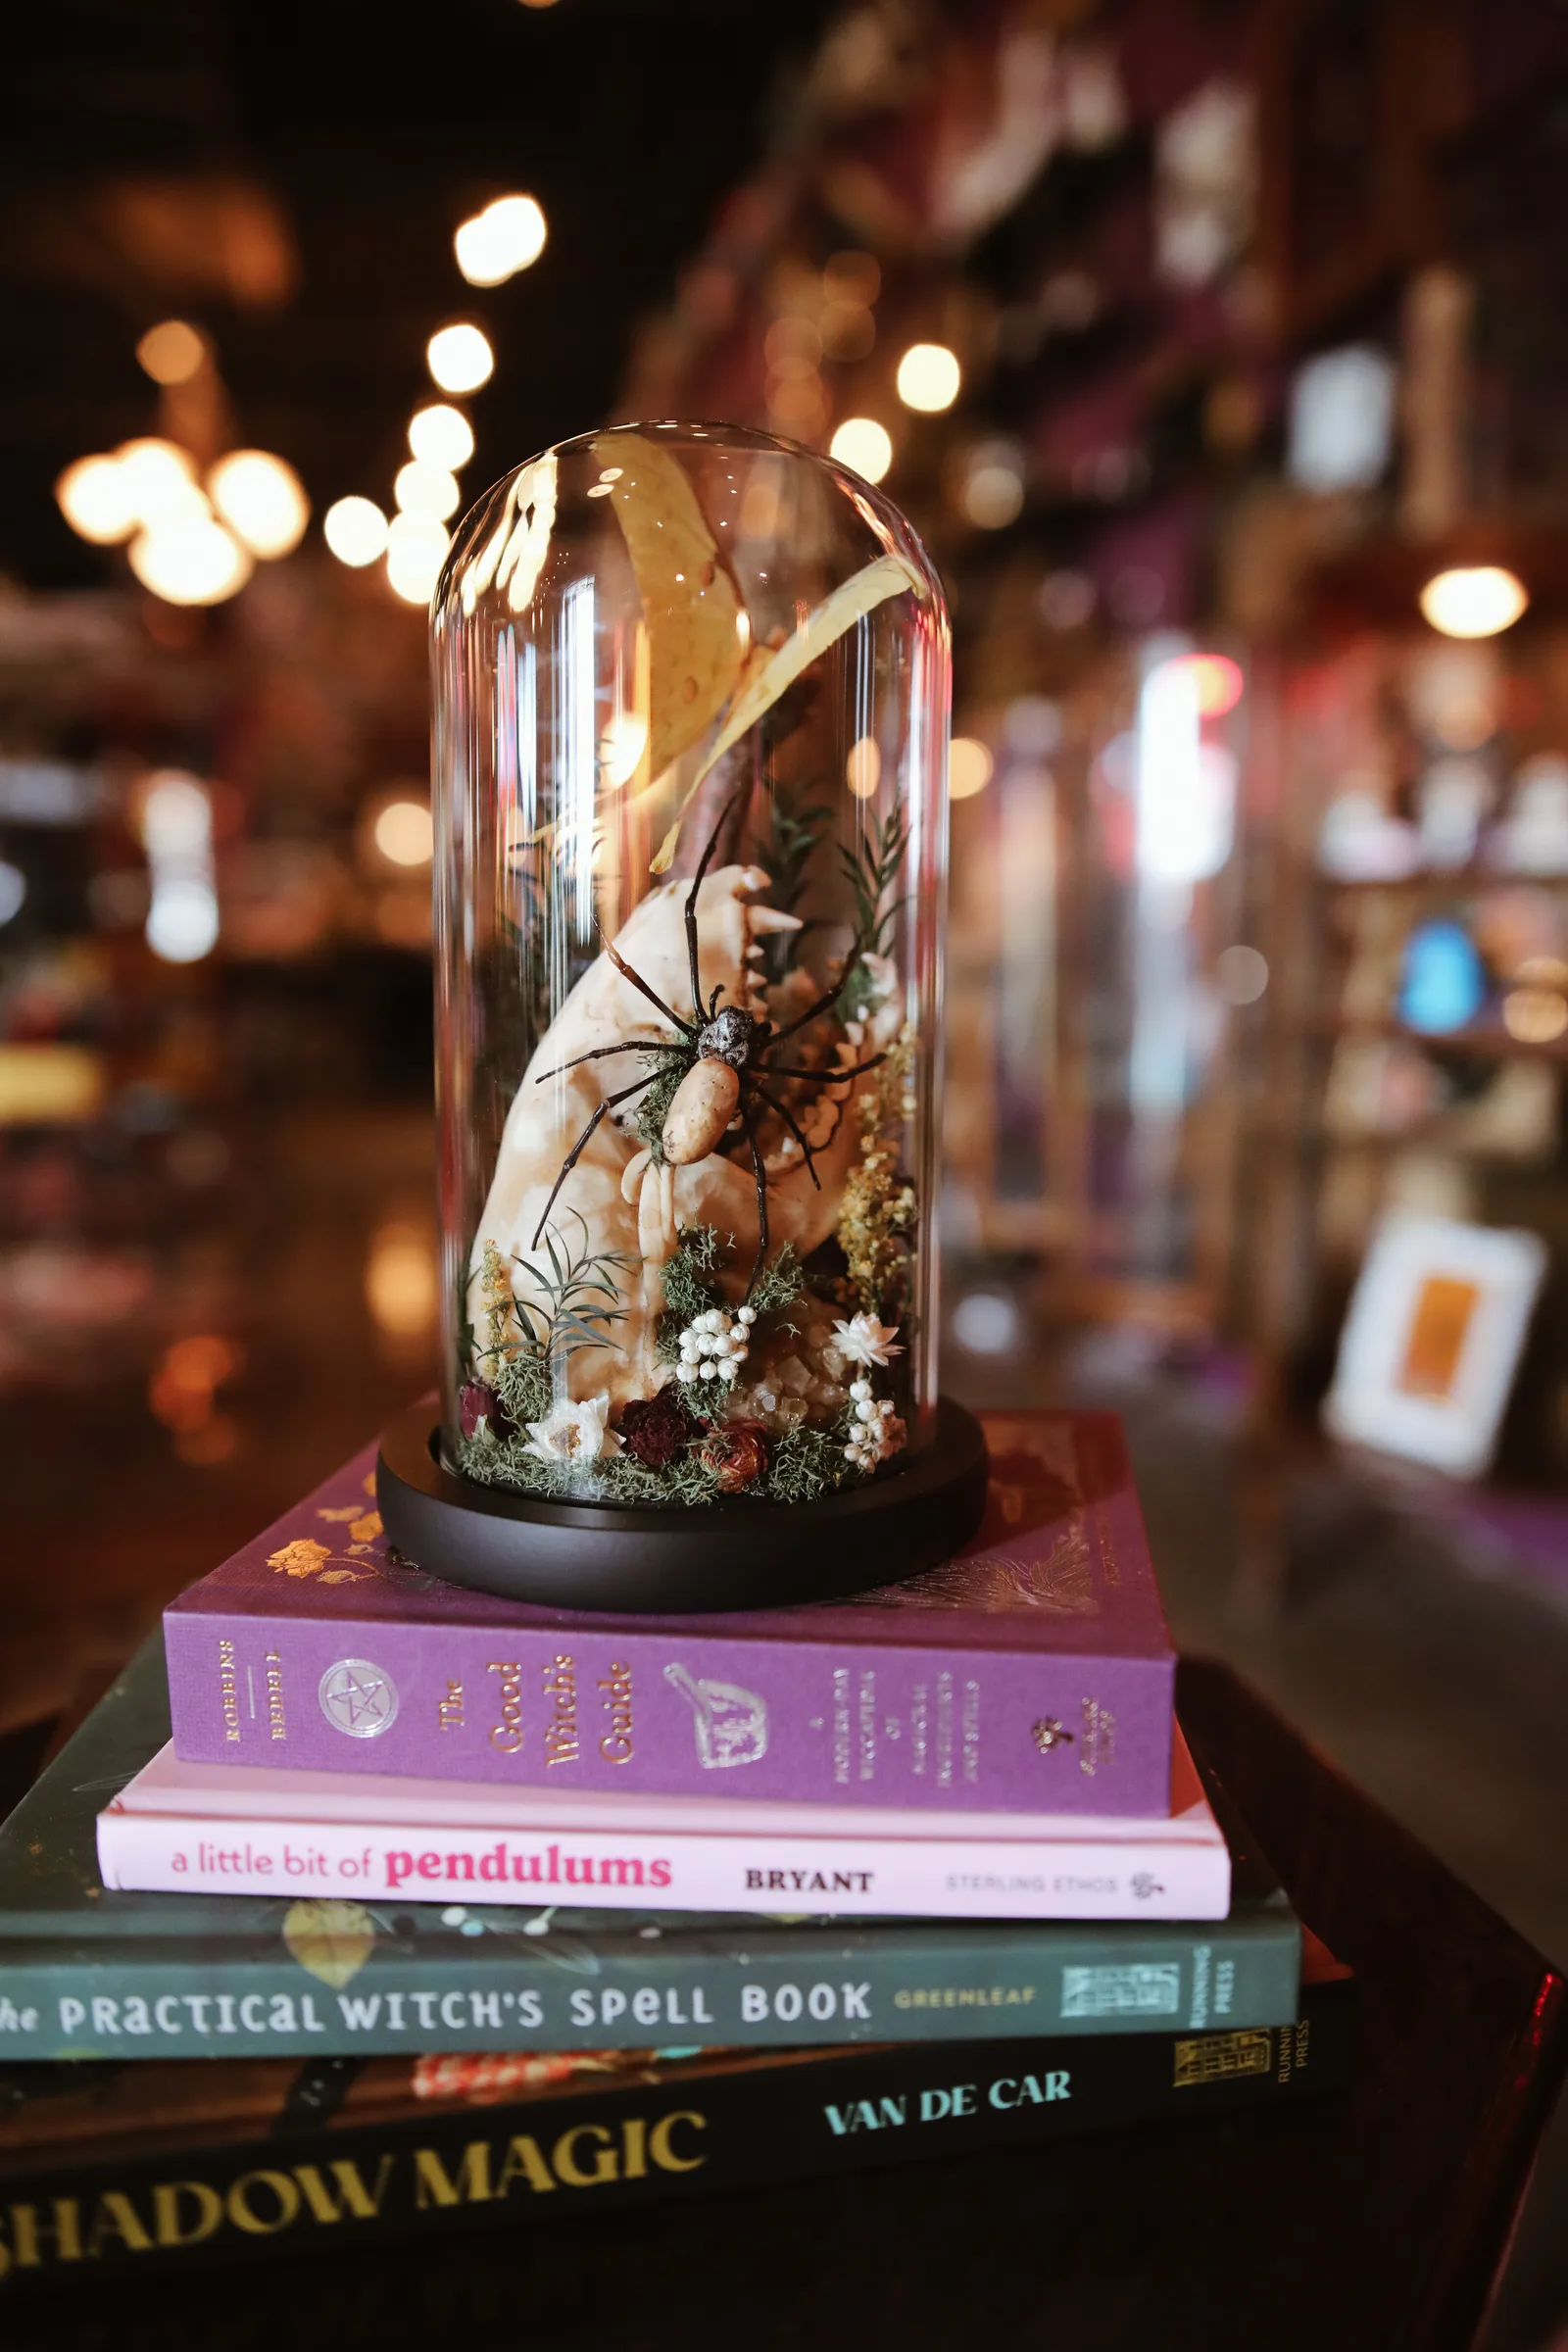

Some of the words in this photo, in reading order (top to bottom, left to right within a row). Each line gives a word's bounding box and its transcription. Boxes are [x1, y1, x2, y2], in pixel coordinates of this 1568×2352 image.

[218, 1639, 241, 1743] ROBBINS
[265, 1648, 287, 1740] BEDELL
[438, 1679, 466, 1731] The
[486, 1661, 524, 1754] Good
[542, 1654, 580, 1768] Witch's
[597, 1661, 635, 1764] Guide
[171, 1849, 188, 1873] a
[199, 1843, 274, 1876] little
[284, 1845, 328, 1877] bit
[339, 1847, 373, 1879] of
[384, 1842, 672, 1888] pendulums
[745, 1868, 875, 1893] BRYANT
[338, 1989, 544, 2032] WITCH'S
[742, 1981, 872, 2023] BOOK
[894, 1986, 1037, 2010] GREENLEAF
[1189, 1945, 1211, 2029] RUNNING
[1214, 1960, 1235, 2014] PRESS
[1296, 2019, 1309, 2067] PRESS
[823, 2094, 906, 2135] VAN
[919, 2083, 978, 2123] DE
[988, 2069, 1072, 2110] CAR
[0, 2152, 394, 2280] HADOW
[414, 2109, 707, 2211] MAGIC
